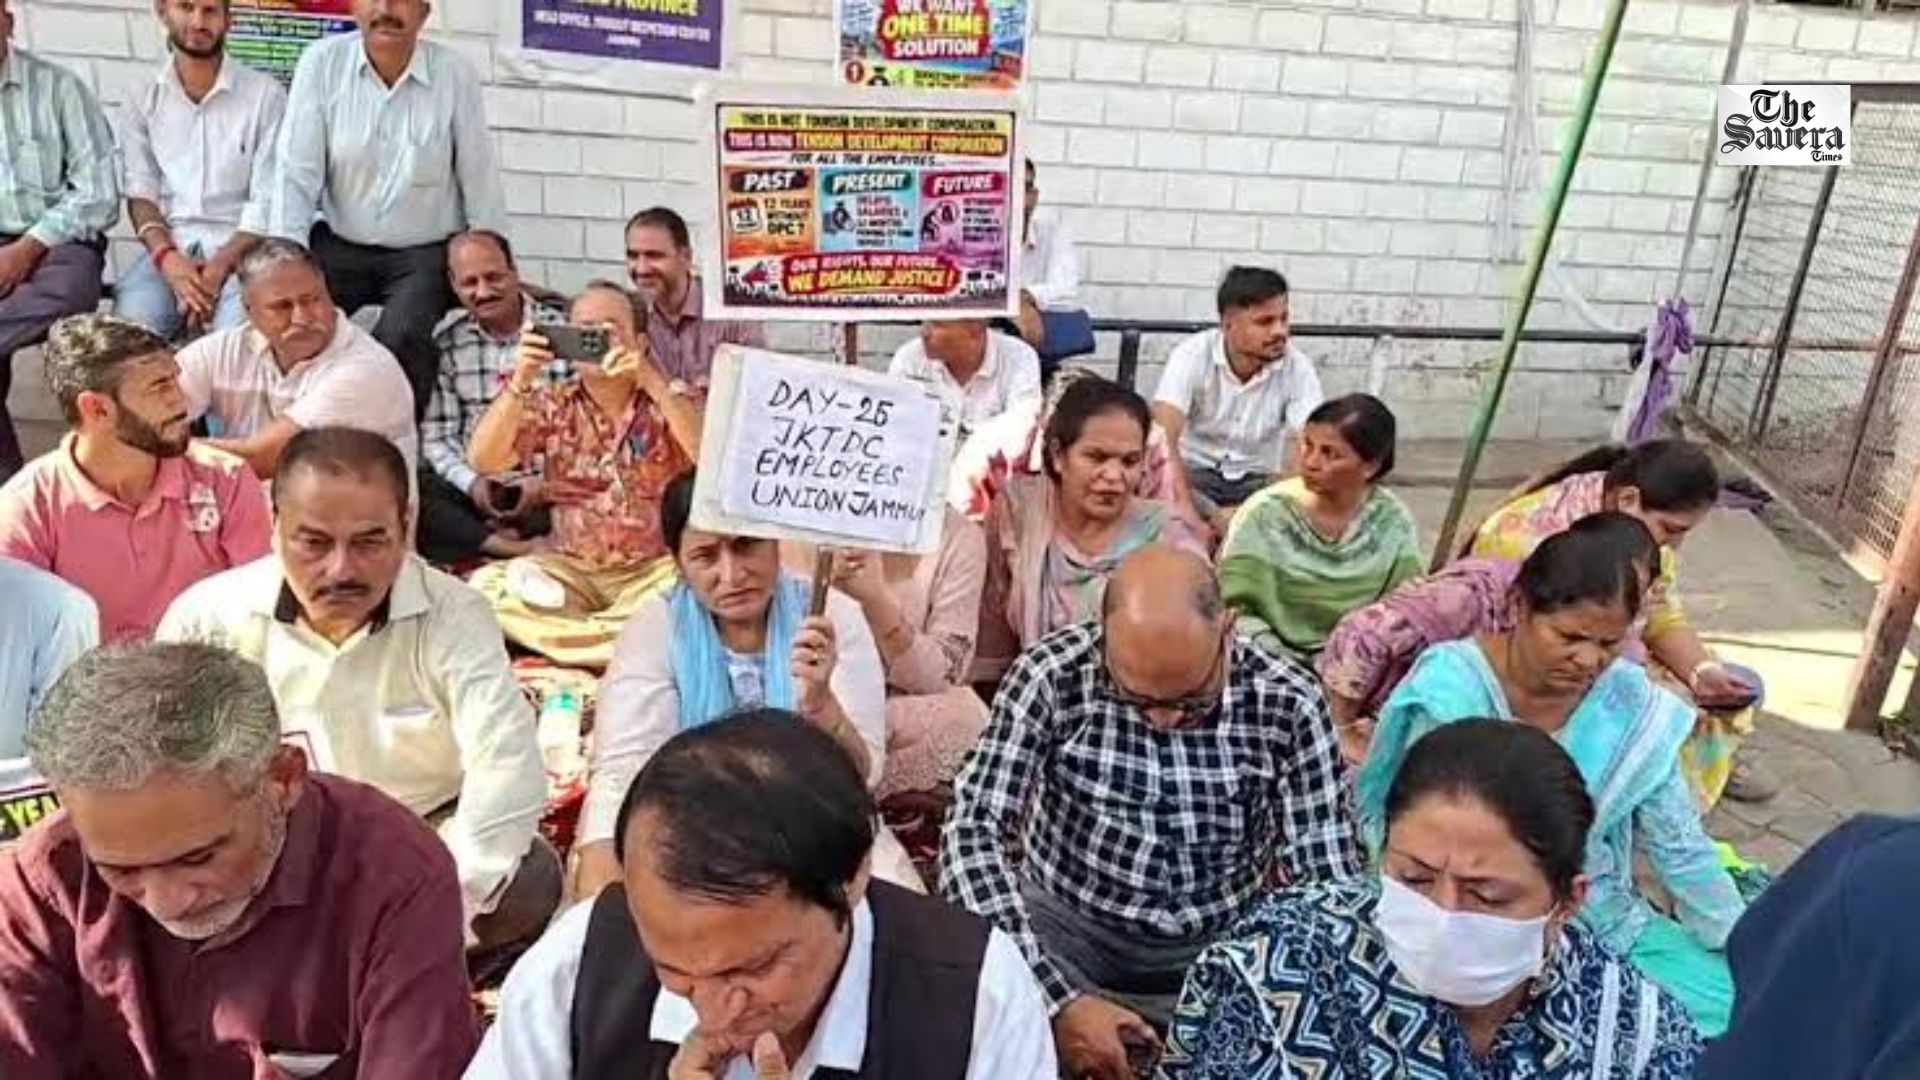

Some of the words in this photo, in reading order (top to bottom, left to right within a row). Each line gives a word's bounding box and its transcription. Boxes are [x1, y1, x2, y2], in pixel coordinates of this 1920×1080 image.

[883, 13, 930, 38] ONE
[934, 13, 985, 36] TIME
[893, 38, 980, 57] SOLUTION
[742, 114, 764, 125] THIS
[767, 114, 777, 125] IS
[780, 114, 801, 126] NOT
[806, 114, 848, 127] TOURISM
[853, 116, 924, 129] DEVELOPMENT
[926, 118, 995, 130] CORPORATION
[796, 132, 843, 150] TENSION
[847, 133, 927, 151] DEVELOPMENT
[930, 135, 1002, 153] CORPORATION
[791, 153, 813, 163] FOR
[817, 154, 836, 164] ALL
[843, 154, 863, 164] THE
[743, 171, 796, 191] PAST
[832, 174, 906, 193] PRESENT
[934, 174, 994, 195] FUTURE
[764, 198, 777, 209] 12
[780, 199, 811, 209] YEARS
[767, 222, 796, 235] DPC
[791, 257, 818, 271] OUR
[869, 255, 893, 268] OUR
[790, 273, 813, 292] WE
[819, 270, 885, 288] DEMAND
[888, 269, 944, 287] JUSTICE
[772, 415, 884, 460] JKTDC
[755, 448, 905, 487] EMPLOYEES
[751, 480, 846, 512] UNION
[847, 490, 925, 522] JAMMU
